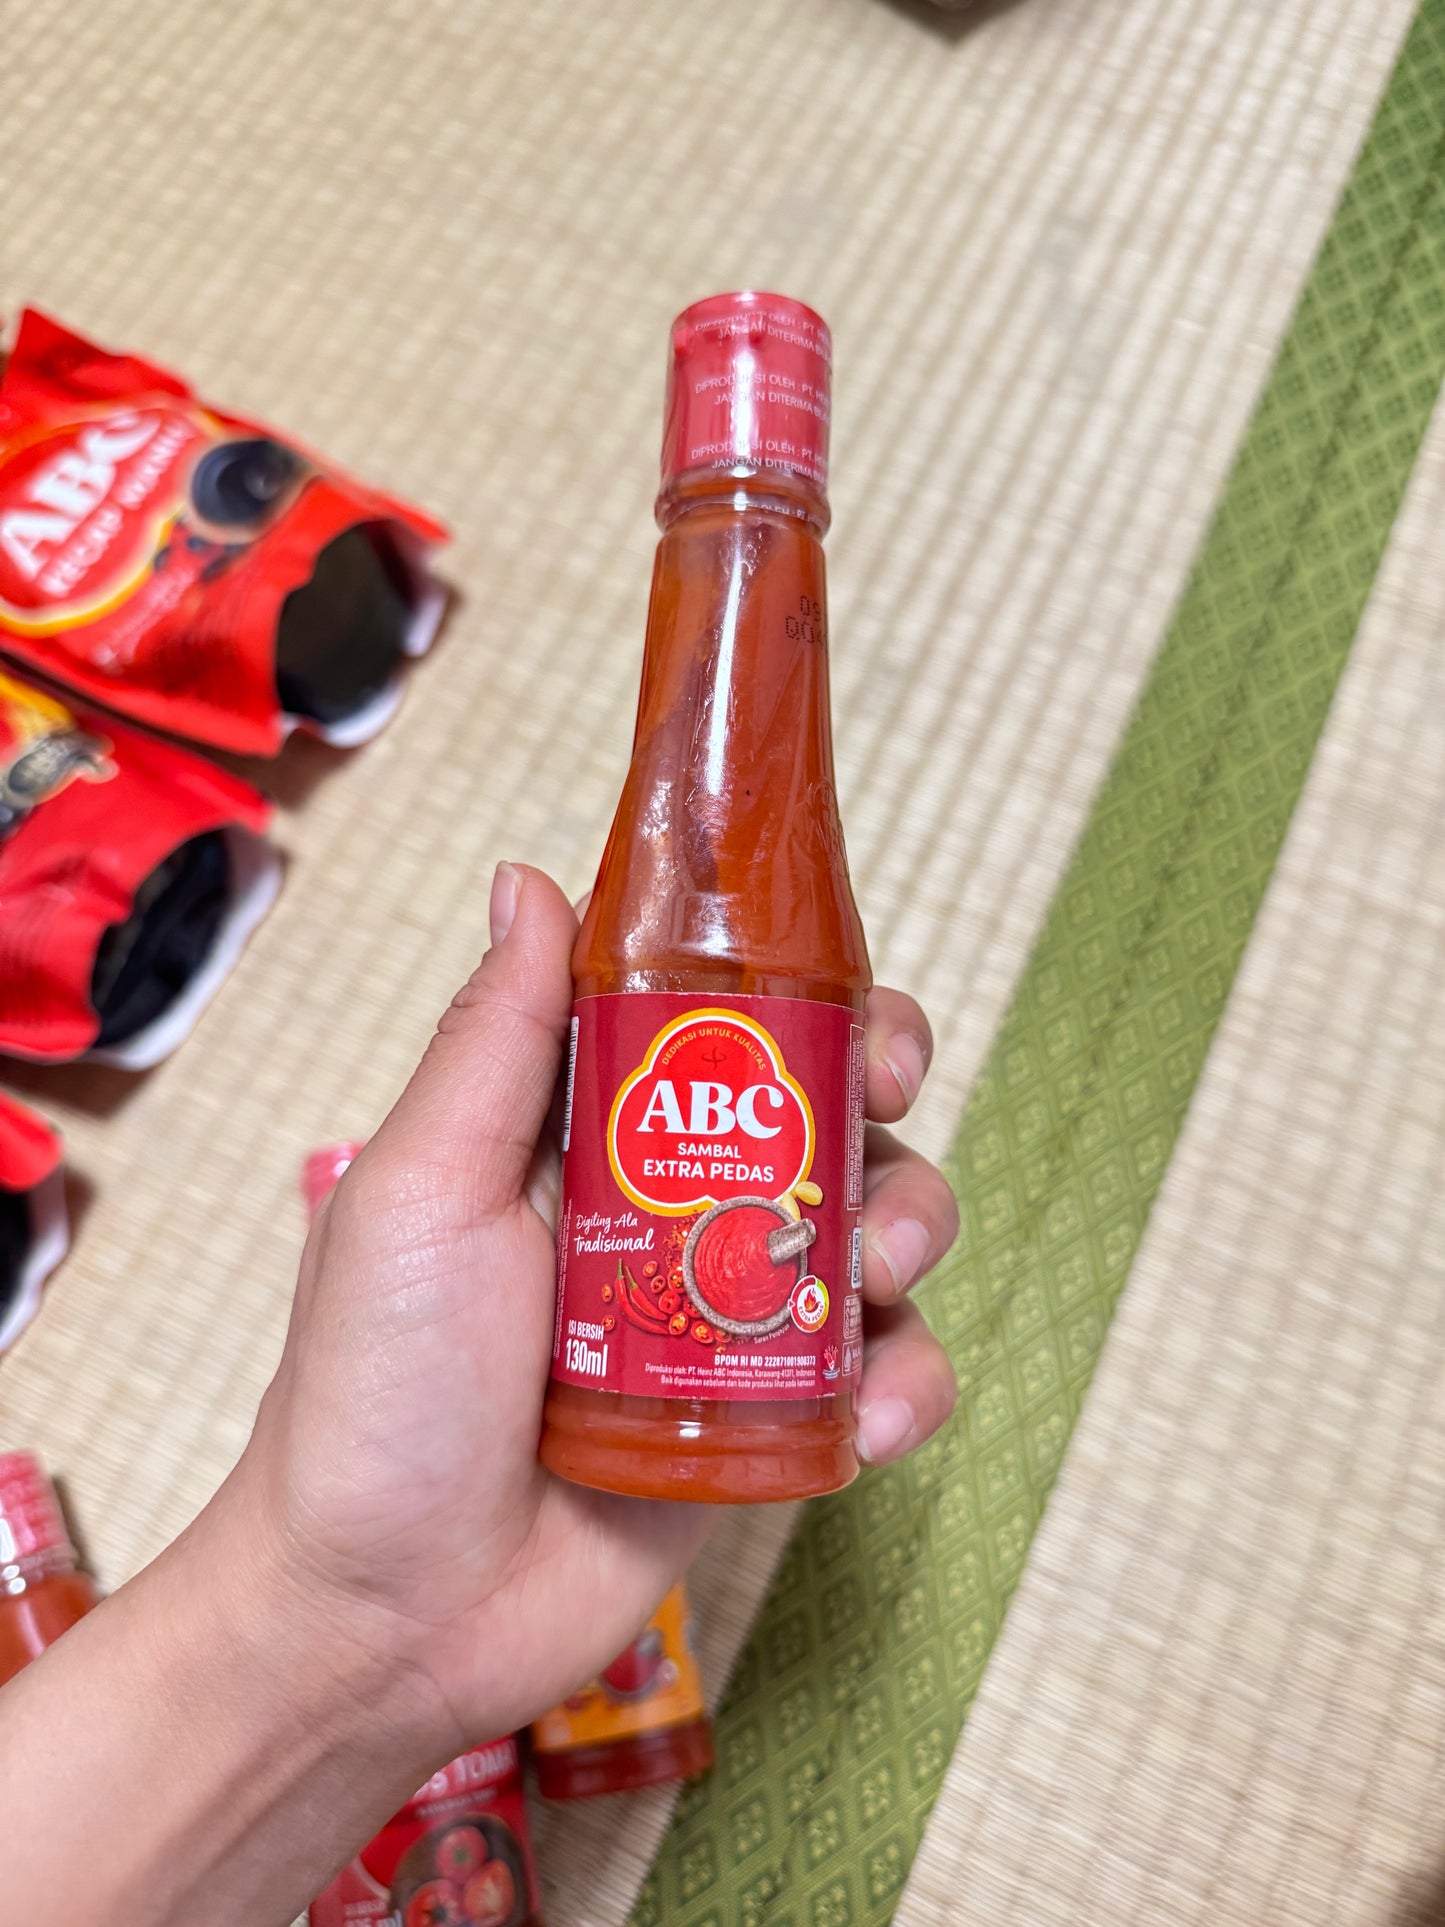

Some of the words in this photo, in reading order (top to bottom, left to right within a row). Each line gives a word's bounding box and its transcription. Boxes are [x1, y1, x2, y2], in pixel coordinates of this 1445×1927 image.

[767, 324, 814, 353] DITERIMA
[768, 374, 796, 391] OLEH
[768, 391, 813, 416] DITERIMA
[766, 440, 796, 455] OLEH
[711, 457, 763, 470] JANGAN
[765, 457, 812, 480] DITERIMA
[1, 406, 163, 581] ABC
[662, 1030, 697, 1066] DEDIKASI
[699, 1027, 733, 1039] UNTUK
[733, 1033, 767, 1071] KUALITAS
[636, 1080, 785, 1139] ABC
[677, 1142, 743, 1159] SAMBAL
[643, 1159, 706, 1180] EXTRA
[709, 1162, 775, 1183] PEDAS
[576, 1211, 612, 1235] Digiling
[613, 1211, 638, 1228] Ala
[568, 1319, 577, 1336] ISI
[577, 1321, 605, 1341] BERSIH
[566, 1337, 608, 1378] 130ml
[645, 1362, 673, 1375] Diproduksi
[687, 1366, 697, 1376] PT.
[697, 1366, 713, 1377] Heinz
[713, 1367, 726, 1377] ABC
[714, 1354, 739, 1367] BPOM
[740, 1355, 749, 1367] RI
[750, 1355, 763, 1367] MD
